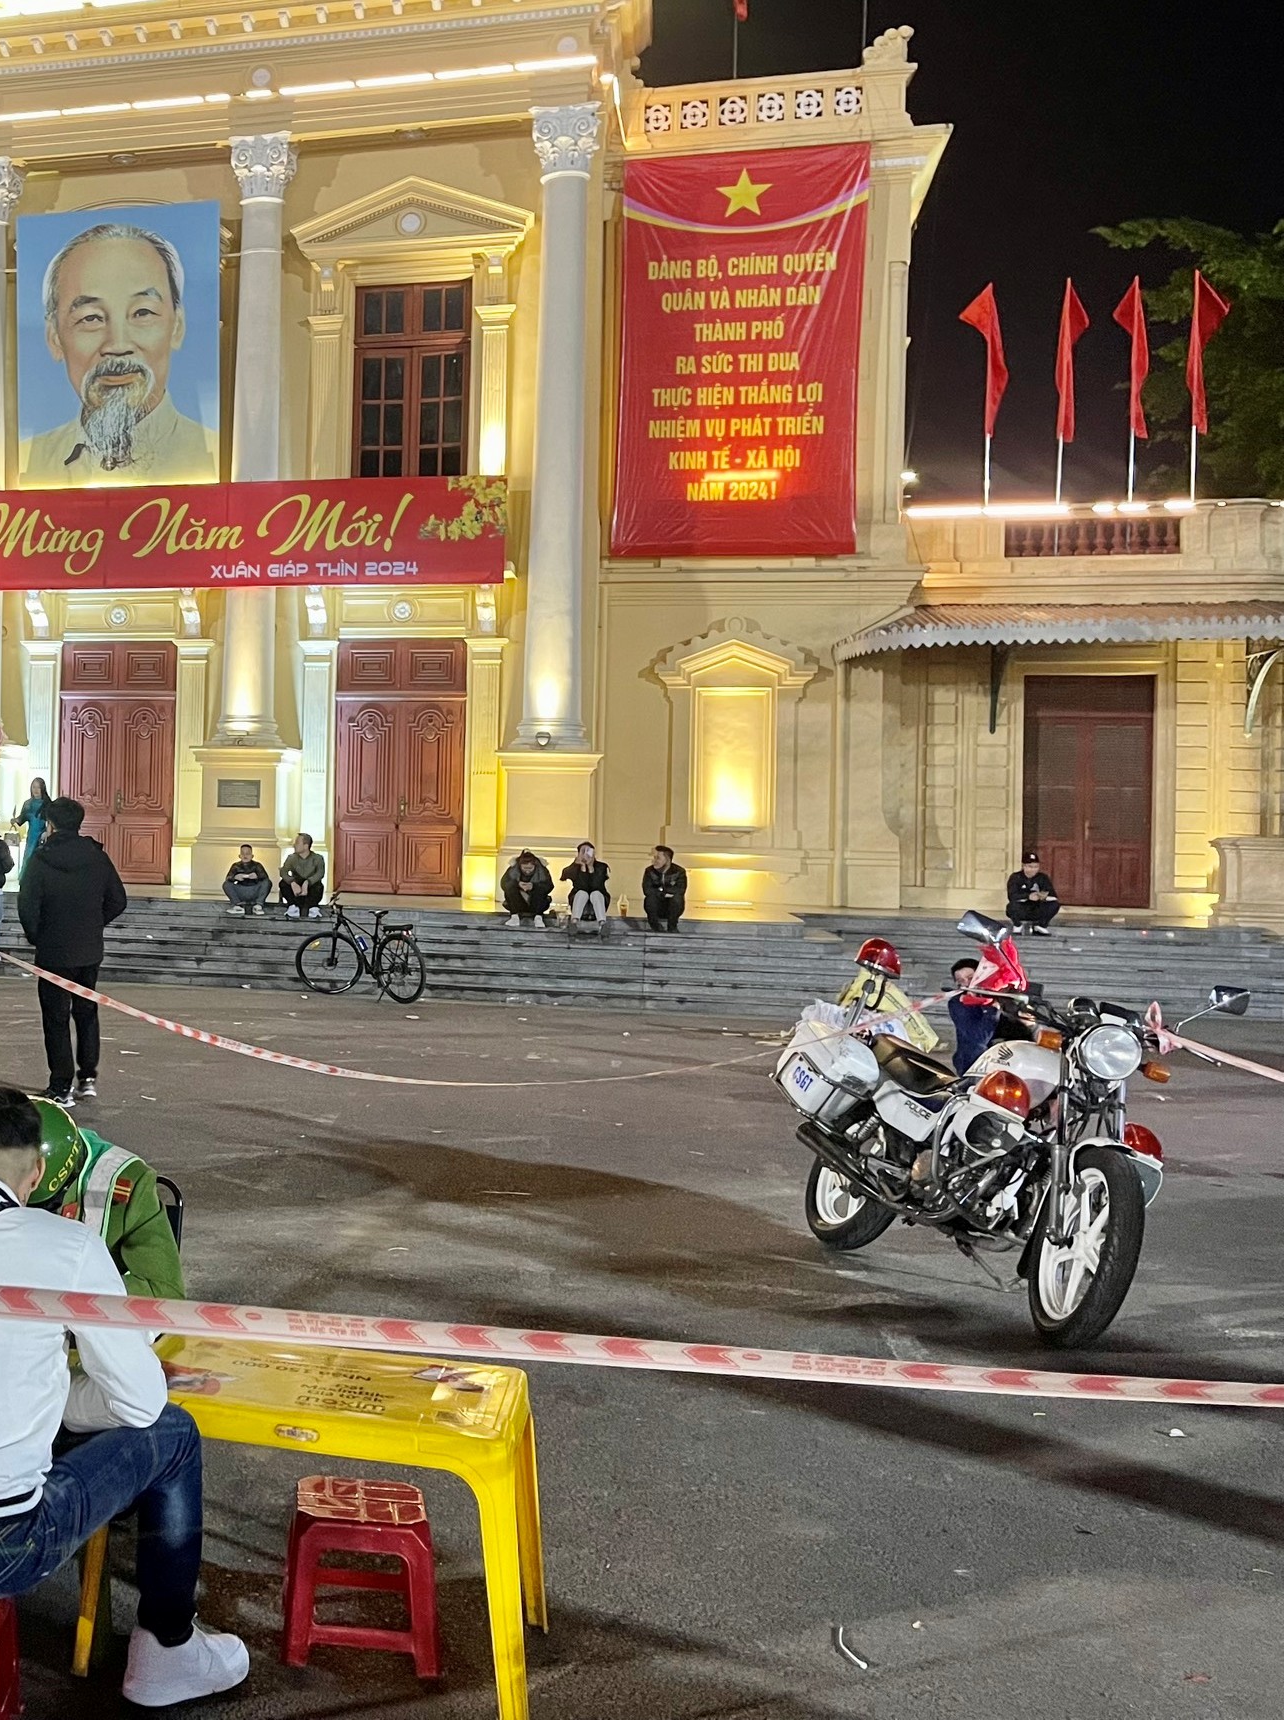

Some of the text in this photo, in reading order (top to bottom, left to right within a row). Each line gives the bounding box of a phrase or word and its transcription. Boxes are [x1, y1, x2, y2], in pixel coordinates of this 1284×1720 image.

[647, 247, 837, 282] ĐẢNG BỘ, CHÍNH QUYỀN
[661, 282, 822, 313] QUÂN VÀ NHÂN DÂN
[693, 313, 785, 342] THÀNH PHỐ
[675, 351, 800, 375] RA SỨC THI ĐUA
[652, 378, 823, 411] THỰC HIỆN THẮNG LỢI
[648, 408, 824, 442] NHIỆM VỤ PHÁT TRIỂN
[668, 451, 708, 470] KINH
[712, 445, 732, 469] TẾ
[745, 446, 768, 469] XÃ
[772, 445, 801, 472] HỘI
[687, 477, 725, 501] NĂM
[118, 497, 245, 558] Năm
[256, 493, 414, 556] Mới!
[210, 559, 418, 579] XUÂN GIÁP THÌN 2024
[792, 1065, 815, 1093] CSGT
[904, 1100, 932, 1121] POLICE
[47, 1140, 82, 1192] CSTT
